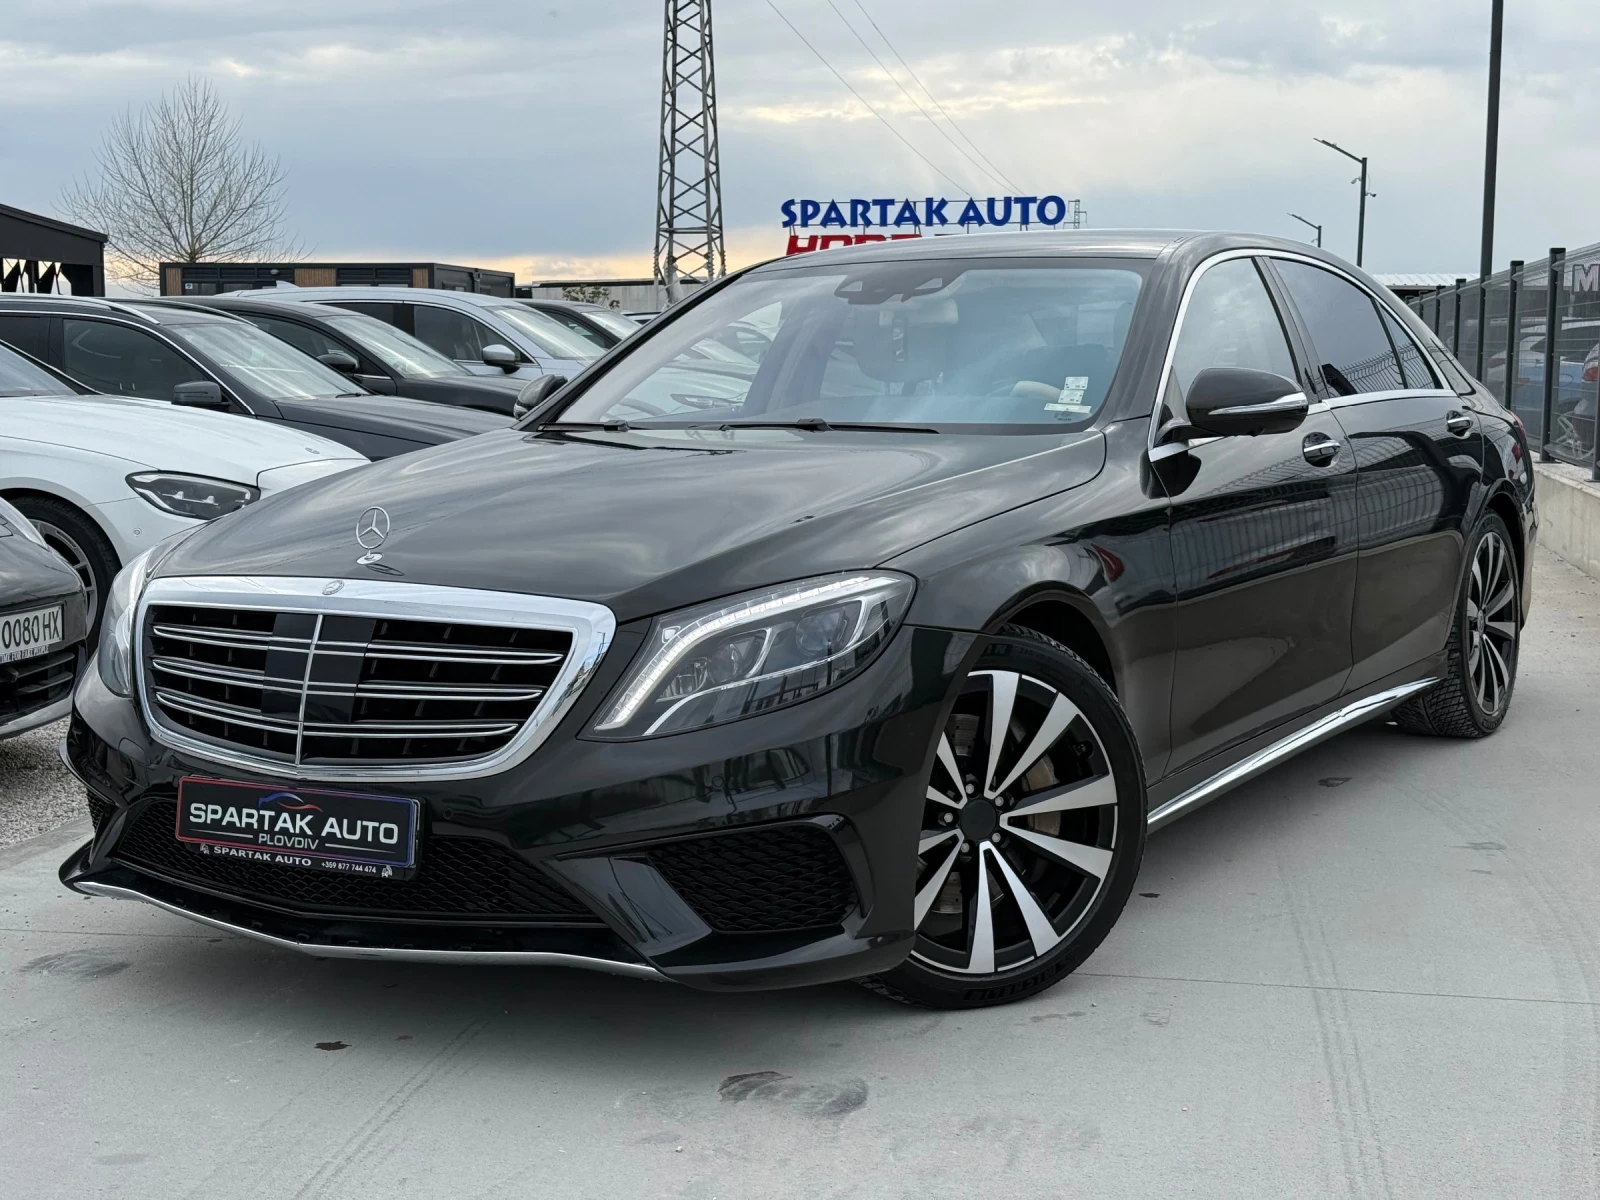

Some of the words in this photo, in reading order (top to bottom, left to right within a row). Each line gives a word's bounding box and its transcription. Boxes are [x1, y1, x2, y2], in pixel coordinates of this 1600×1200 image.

[781, 197, 949, 228] SPARTAK
[957, 195, 1066, 227] AUTO
[2, 614, 40, 649] 0080
[42, 609, 60, 641] HX
[188, 802, 314, 835] SPARTAK
[320, 817, 399, 845] AUTO
[258, 833, 319, 850] PLOVDIV
[213, 846, 271, 861] SPARTAK
[275, 855, 312, 867] AUTO
[321, 861, 337, 869] +359
[337, 862, 350, 871] 877
[351, 864, 363, 872] 744
[364, 865, 377, 873] 474
